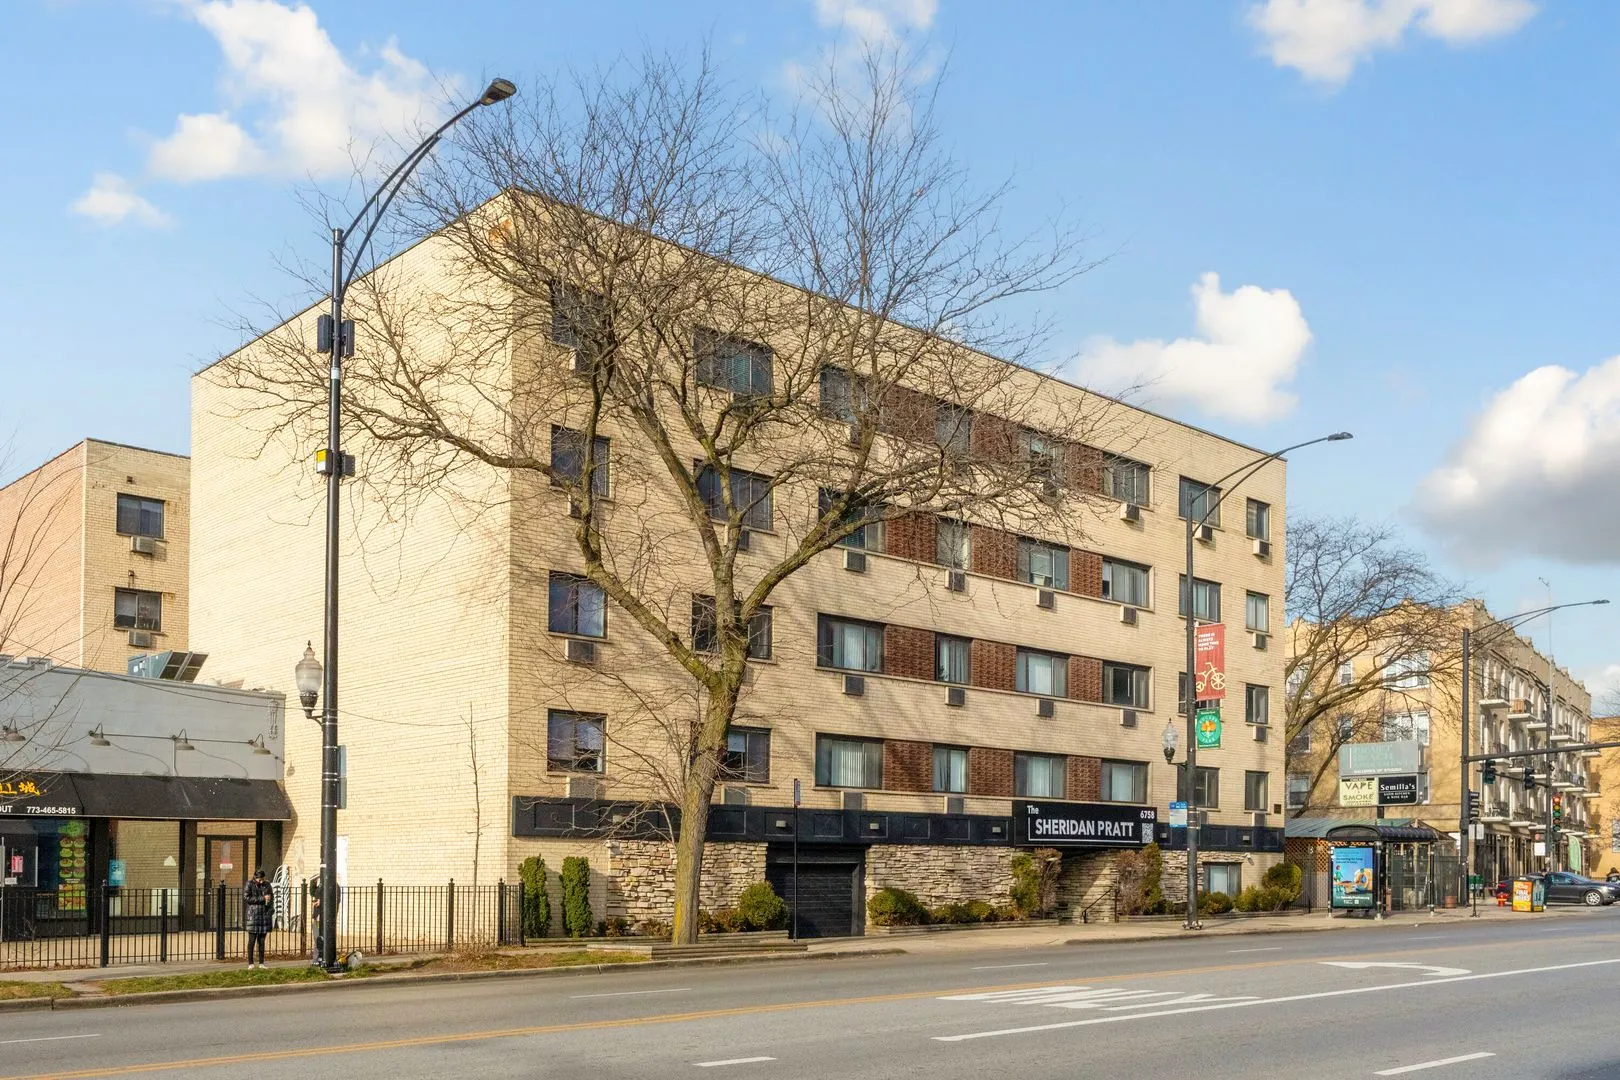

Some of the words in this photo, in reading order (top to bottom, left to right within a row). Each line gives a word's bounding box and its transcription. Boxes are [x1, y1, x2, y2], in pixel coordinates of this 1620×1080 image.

[1345, 781, 1373, 790] VAPE
[1380, 783, 1416, 791] Semilla's
[1343, 793, 1374, 801] SMOKE
[26, 806, 76, 814] 773-465-5815
[1027, 805, 1039, 814] The
[1139, 810, 1155, 819] 6758
[1035, 818, 1095, 836] SHERIDAN
[1097, 820, 1134, 837] PRATT
[935, 985, 1262, 1011] ONLY
